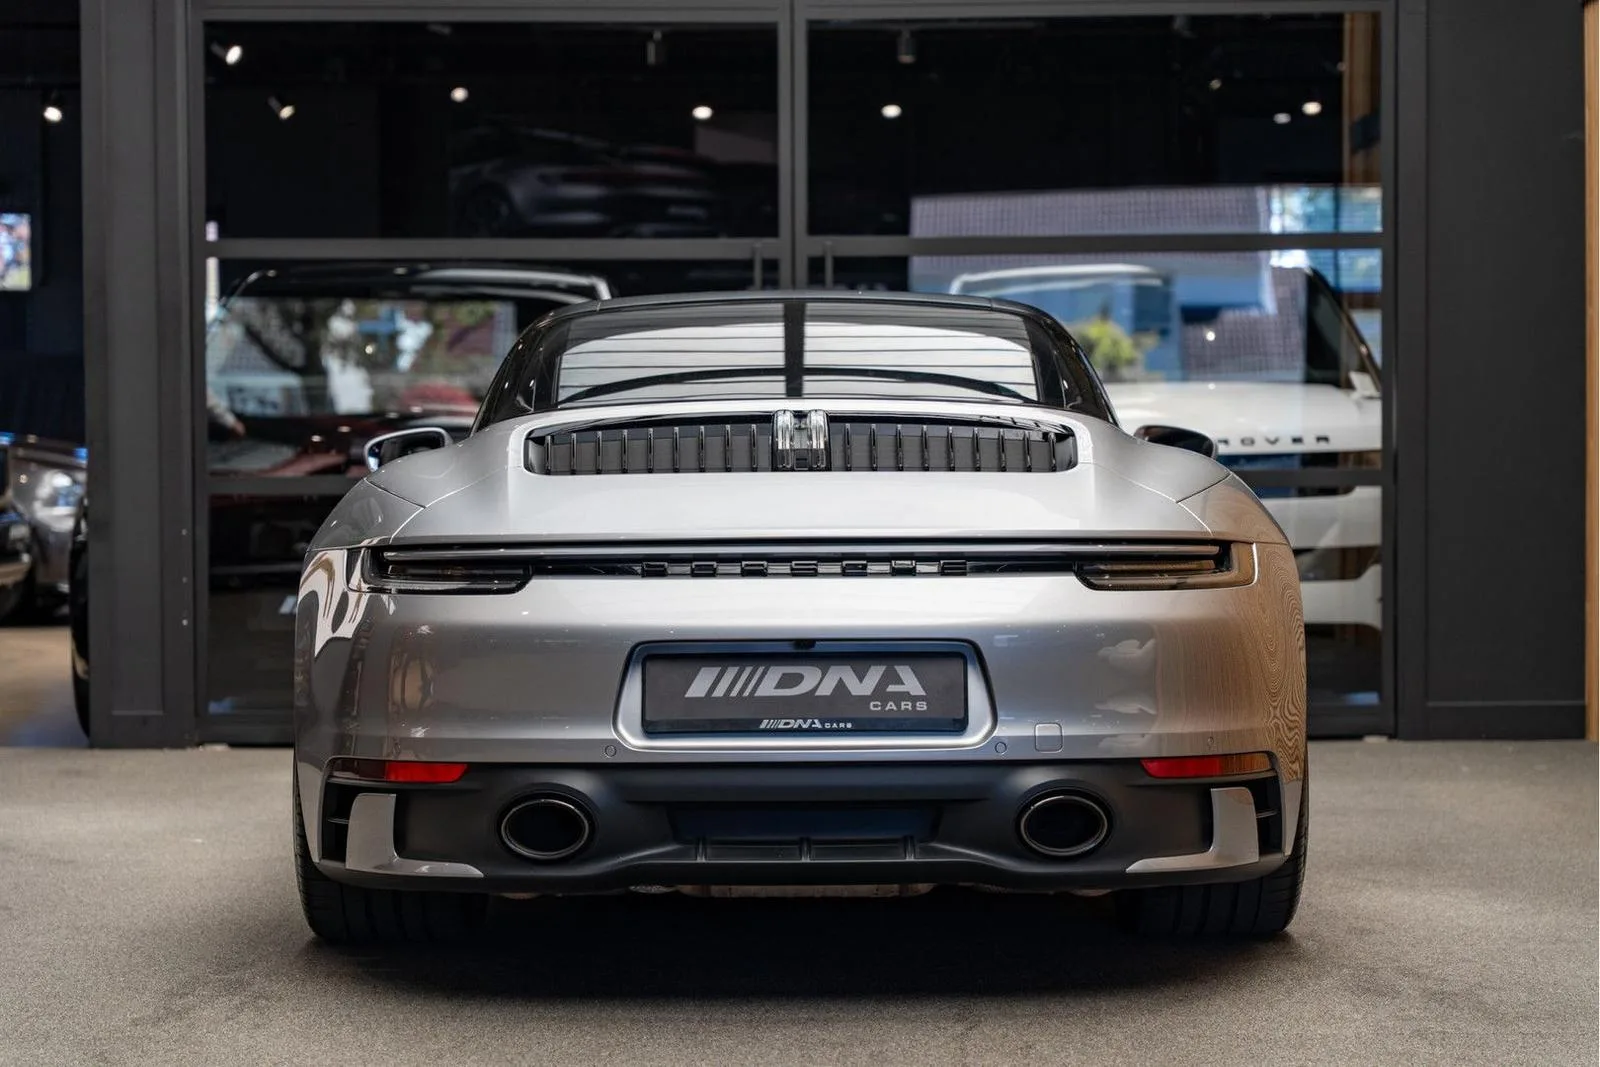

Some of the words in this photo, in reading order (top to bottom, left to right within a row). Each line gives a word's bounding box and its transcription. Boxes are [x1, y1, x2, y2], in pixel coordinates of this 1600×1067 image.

[642, 560, 967, 577] PORSCHE
[754, 664, 927, 698] DNA
[869, 701, 928, 711] CARS
[777, 719, 823, 729] DNA
